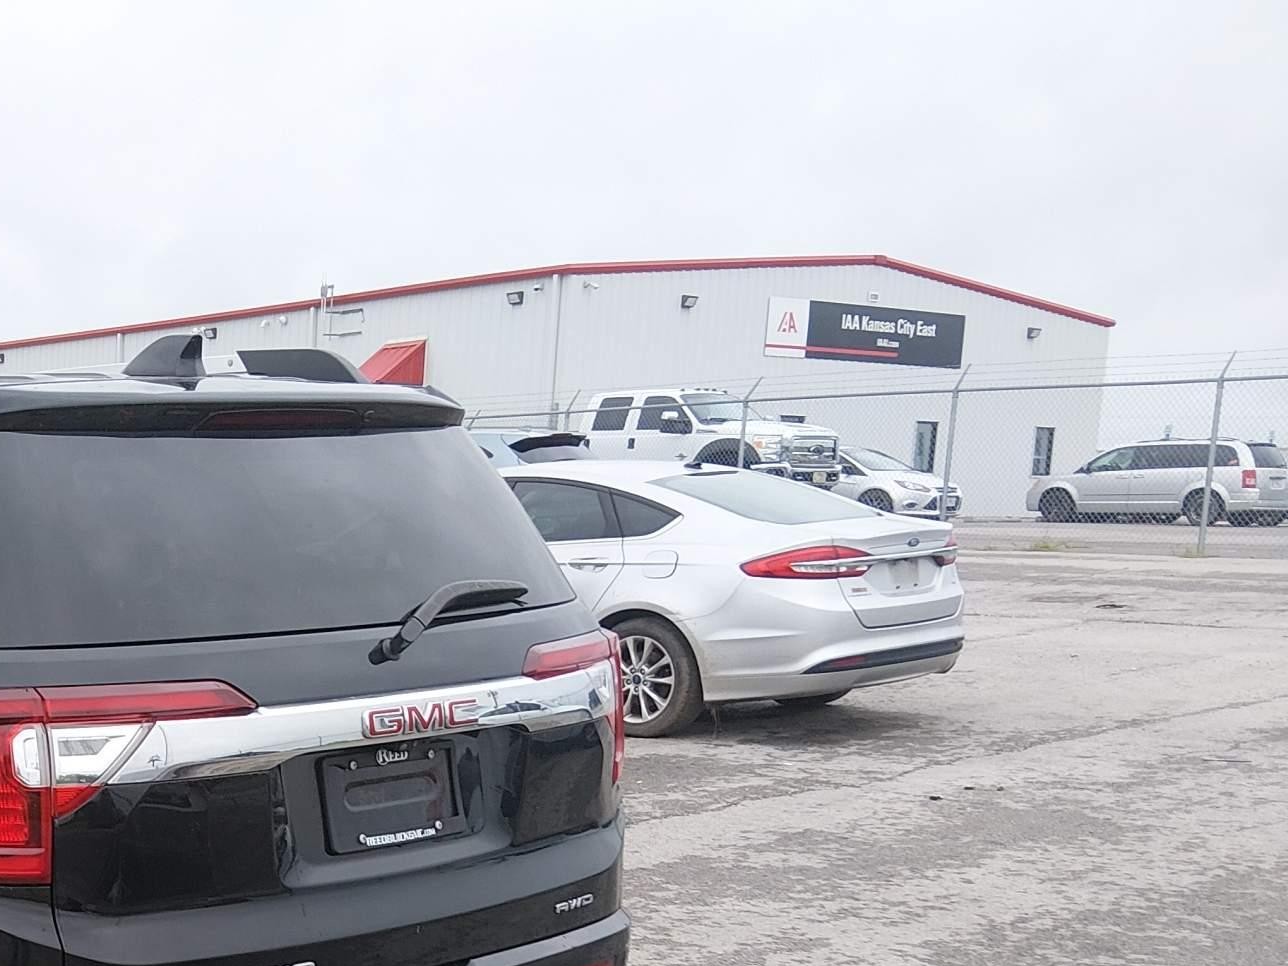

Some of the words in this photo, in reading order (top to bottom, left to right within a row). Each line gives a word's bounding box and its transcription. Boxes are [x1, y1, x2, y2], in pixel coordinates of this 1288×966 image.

[841, 313, 860, 330] IAA
[861, 315, 896, 333] Kansas
[897, 318, 916, 338] City
[916, 320, 937, 337] East
[362, 698, 480, 738] GMC
[554, 893, 594, 914] AWD
